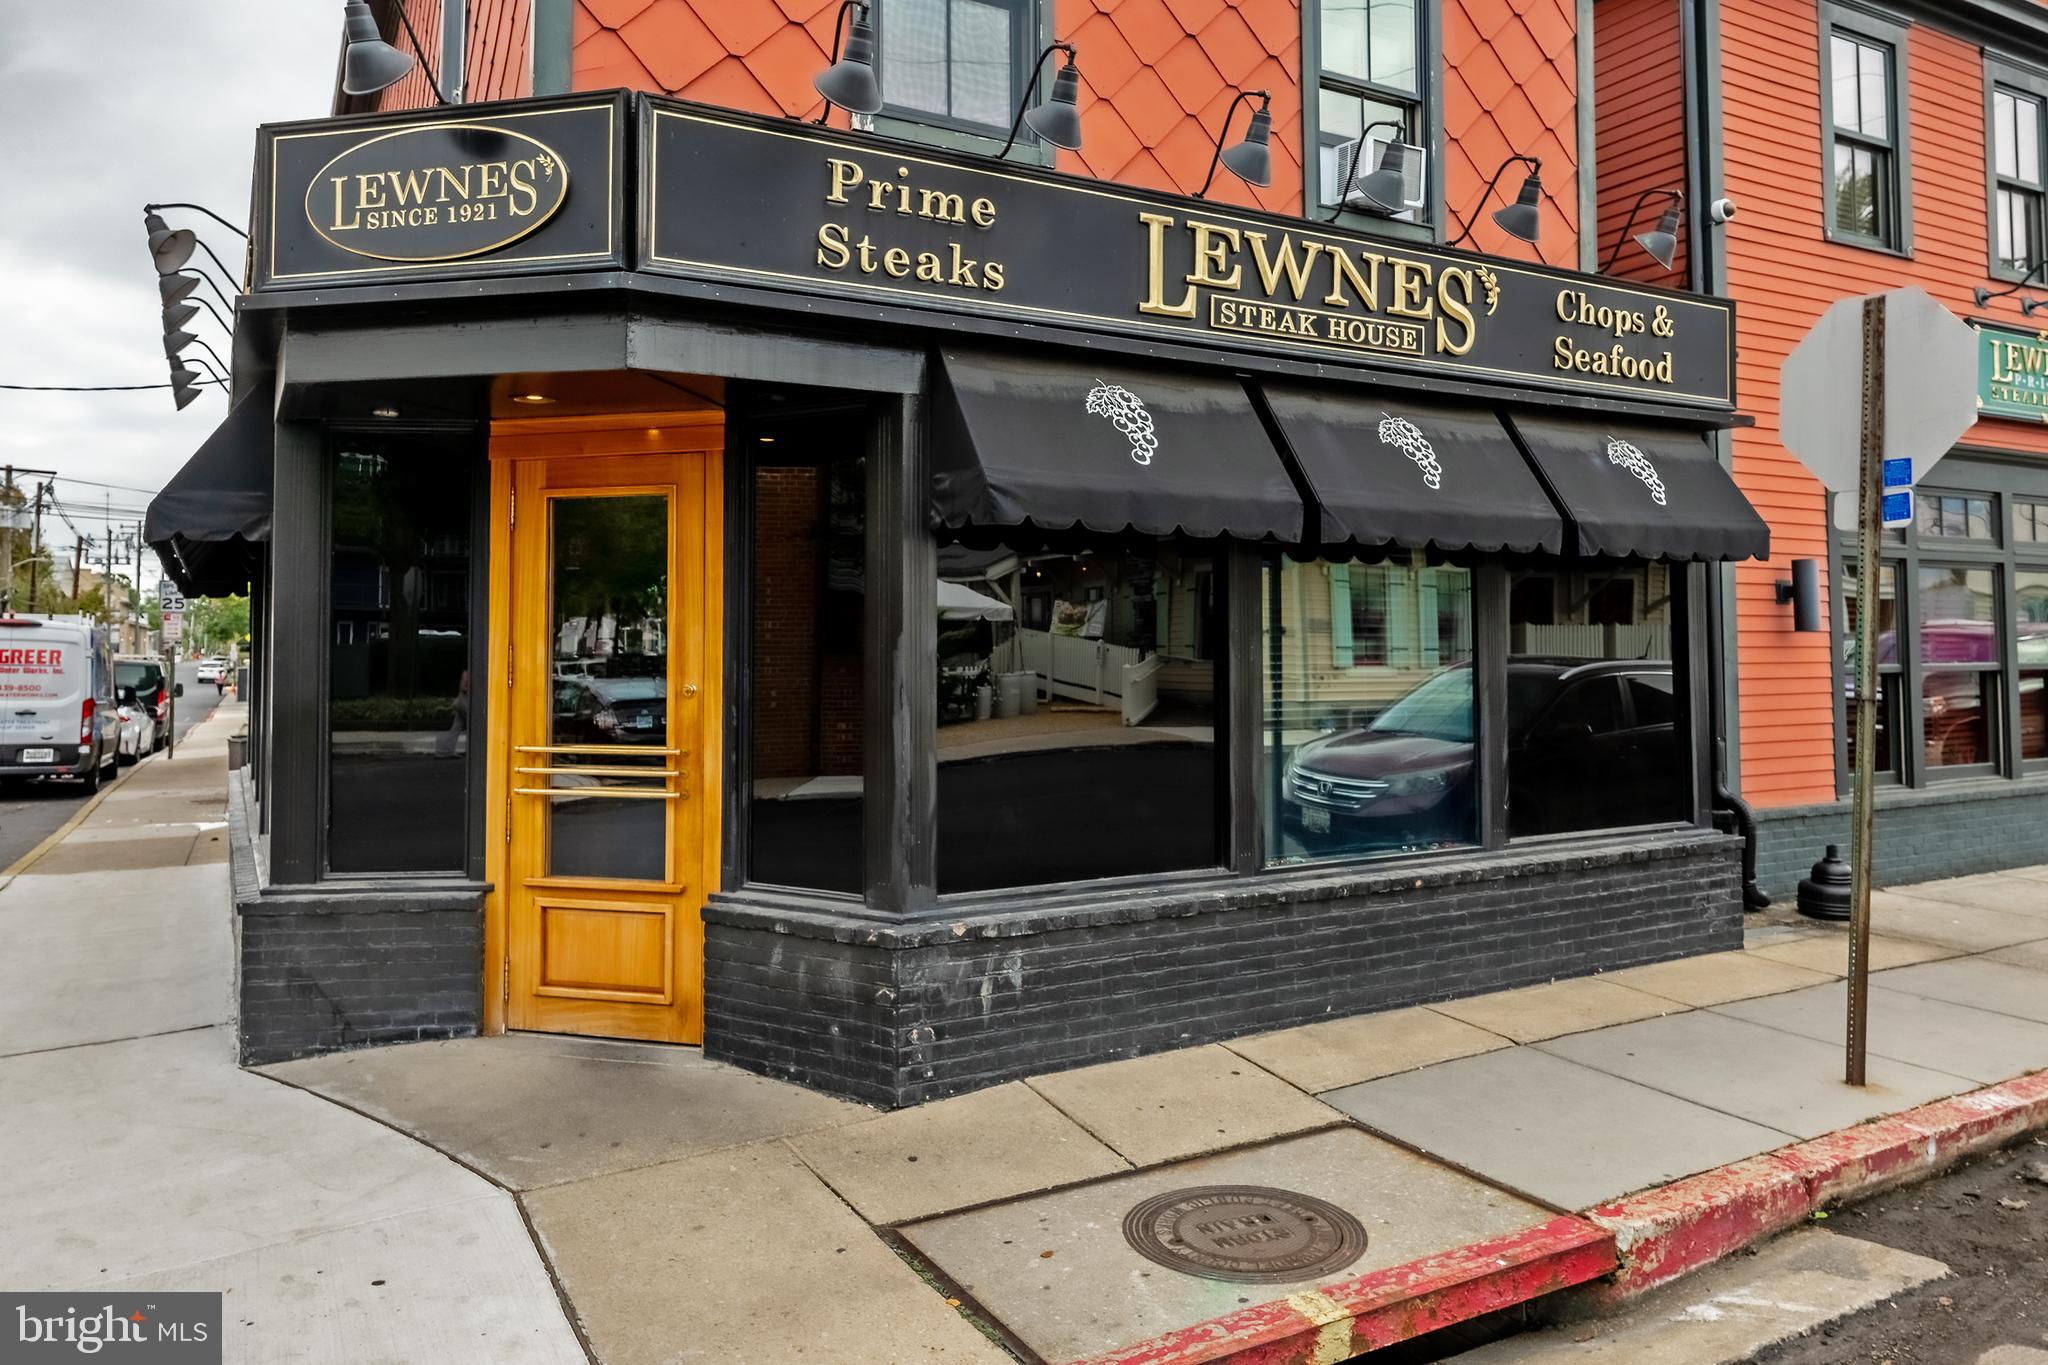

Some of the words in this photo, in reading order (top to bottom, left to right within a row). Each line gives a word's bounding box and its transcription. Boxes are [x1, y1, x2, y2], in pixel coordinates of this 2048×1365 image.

[330, 159, 536, 230] LEWNES
[366, 207, 438, 230] SINCE
[447, 203, 497, 224] 1921
[827, 158, 996, 226] Prime
[817, 223, 1005, 291] Steaks
[1139, 212, 1476, 355] LEWNES
[1221, 303, 1318, 336] STEAK
[1328, 318, 1417, 351] HOUSE
[1556, 289, 1646, 337] Chops
[1652, 304, 1674, 338] &
[1554, 336, 1673, 384] Seafood
[162, 598, 185, 609] 25
